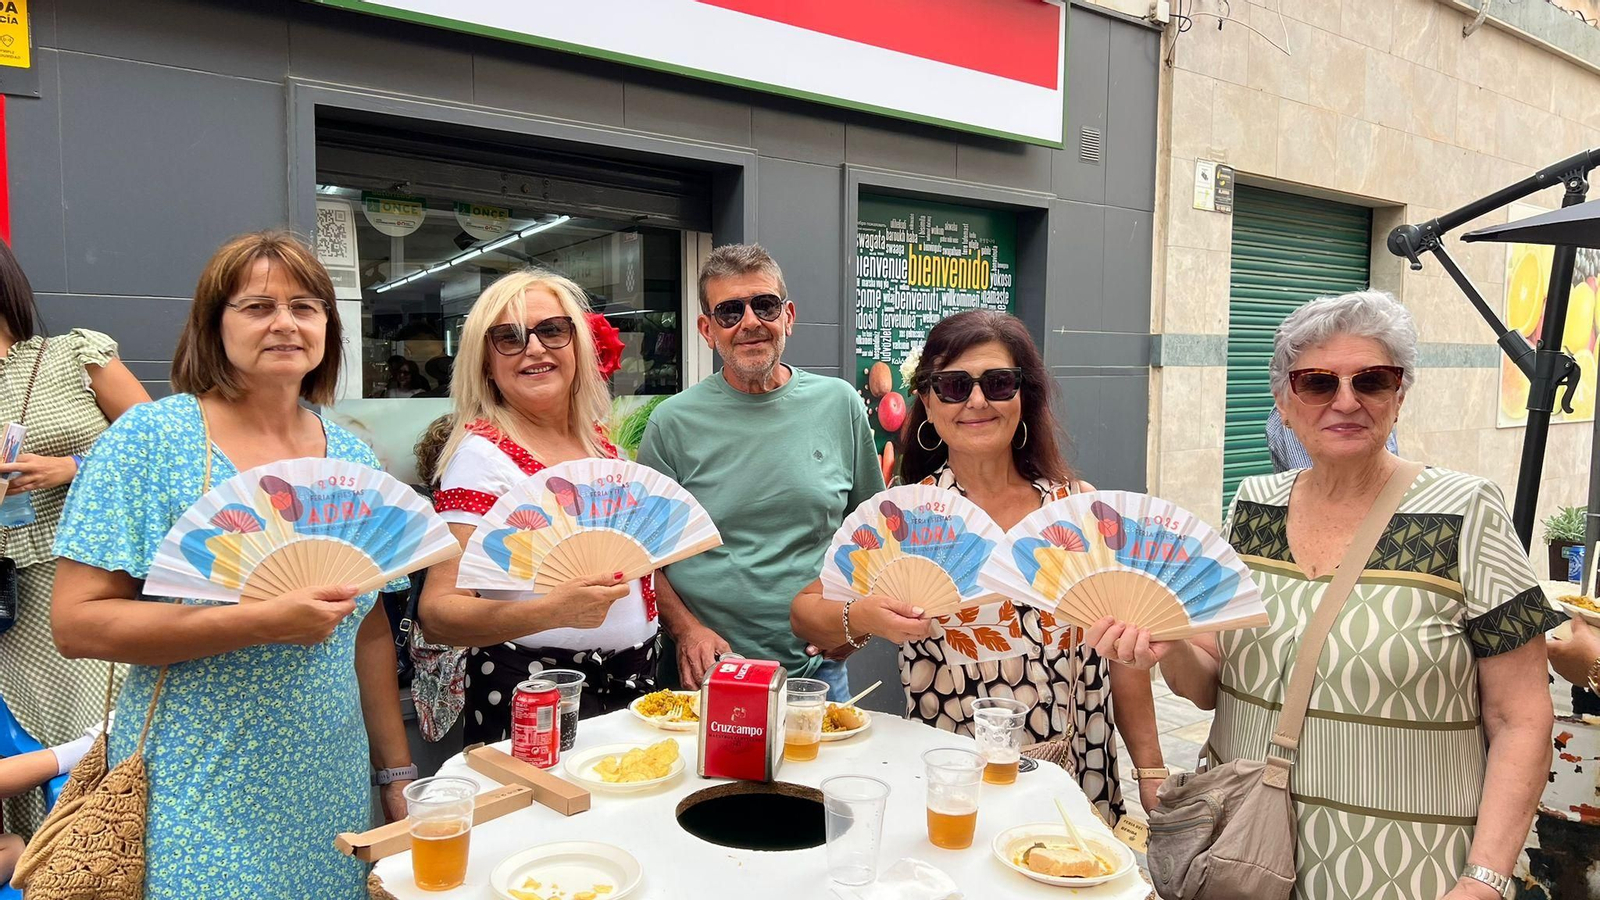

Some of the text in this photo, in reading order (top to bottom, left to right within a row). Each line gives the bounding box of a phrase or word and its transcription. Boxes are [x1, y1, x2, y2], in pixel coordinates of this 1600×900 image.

[382, 202, 419, 215] ONCE
[472, 206, 506, 218] ONCE
[908, 243, 989, 290] bienvenido
[895, 285, 939, 311] benvenuti
[982, 287, 1009, 305] namaste
[881, 309, 916, 329] tervetuloa
[318, 476, 355, 490] 2025
[307, 499, 372, 525] ADRA
[919, 502, 946, 515] 2025
[1144, 515, 1180, 531] 2025
[910, 525, 957, 547] ADRA
[1128, 540, 1190, 563] ADRA
[710, 720, 763, 738] Cruzcampo
